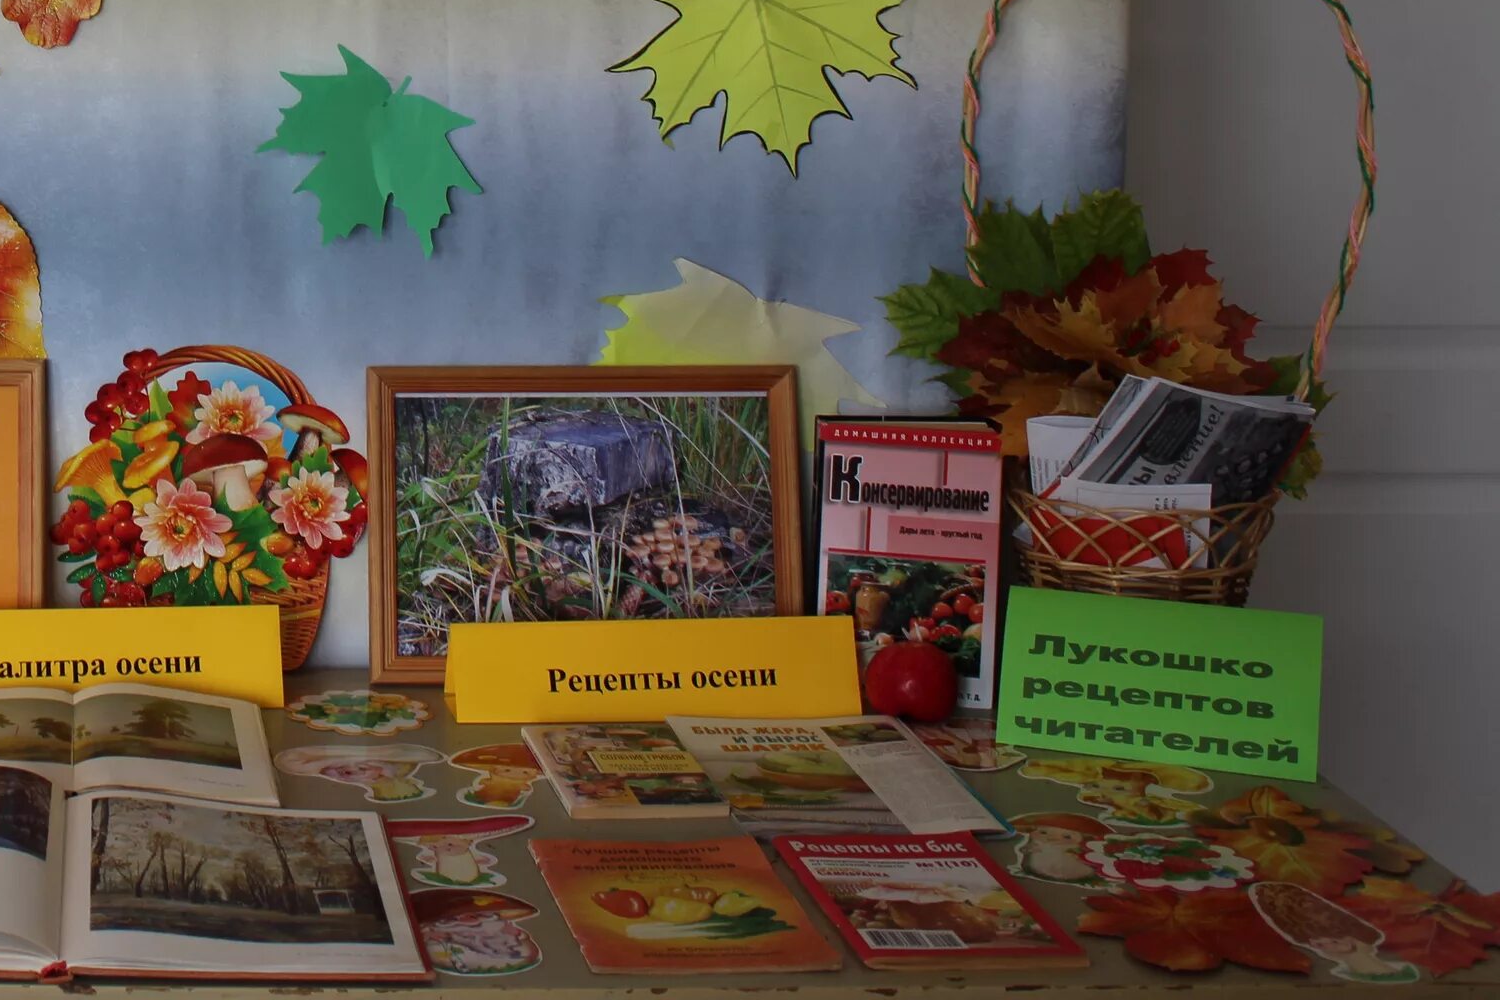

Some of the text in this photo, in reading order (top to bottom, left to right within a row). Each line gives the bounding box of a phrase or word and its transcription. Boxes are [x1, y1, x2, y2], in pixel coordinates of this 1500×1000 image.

[833, 428, 993, 447] ДОМАШНЯЯ КОЛЛЕКЦИЯ
[829, 453, 990, 512] Консервирование
[115, 654, 202, 677] осени
[1028, 633, 1274, 679] Лукошко
[546, 667, 778, 695] Рецепты осени
[1022, 676, 1275, 720] рецептов
[690, 725, 816, 738] БЫЛА ЖАРА,
[732, 735, 824, 745] И ВЫРОС
[1014, 715, 1300, 765] читателей
[720, 743, 829, 752] ШАРИК
[788, 839, 968, 855] Рецепты на бис
